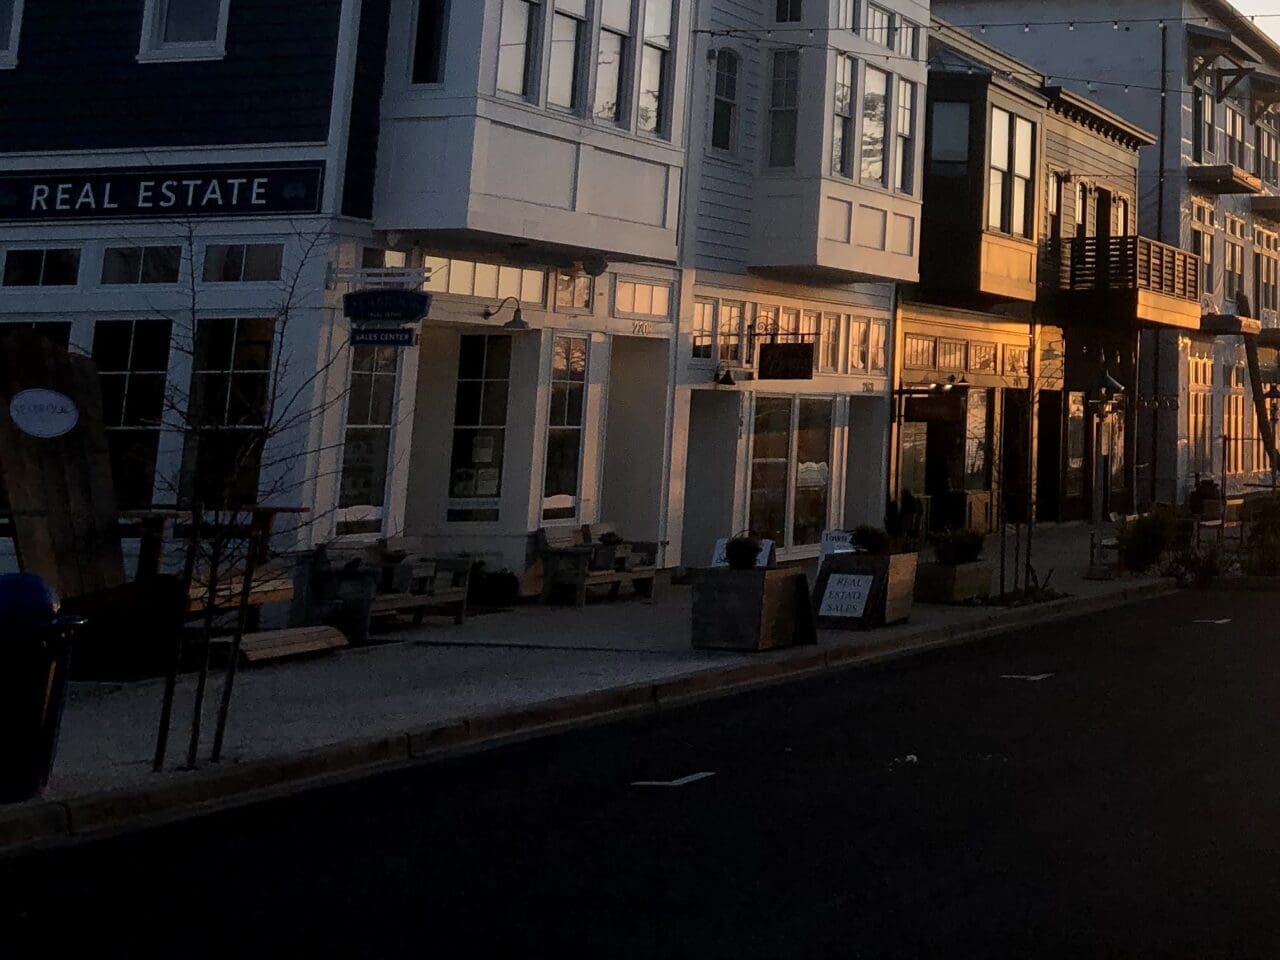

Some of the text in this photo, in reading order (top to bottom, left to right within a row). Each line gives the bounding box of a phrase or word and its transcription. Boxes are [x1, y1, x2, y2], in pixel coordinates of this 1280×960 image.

[31, 177, 270, 211] REAL ESTATE
[837, 578, 862, 587] REAL
[828, 591, 863, 600] ESTATE
